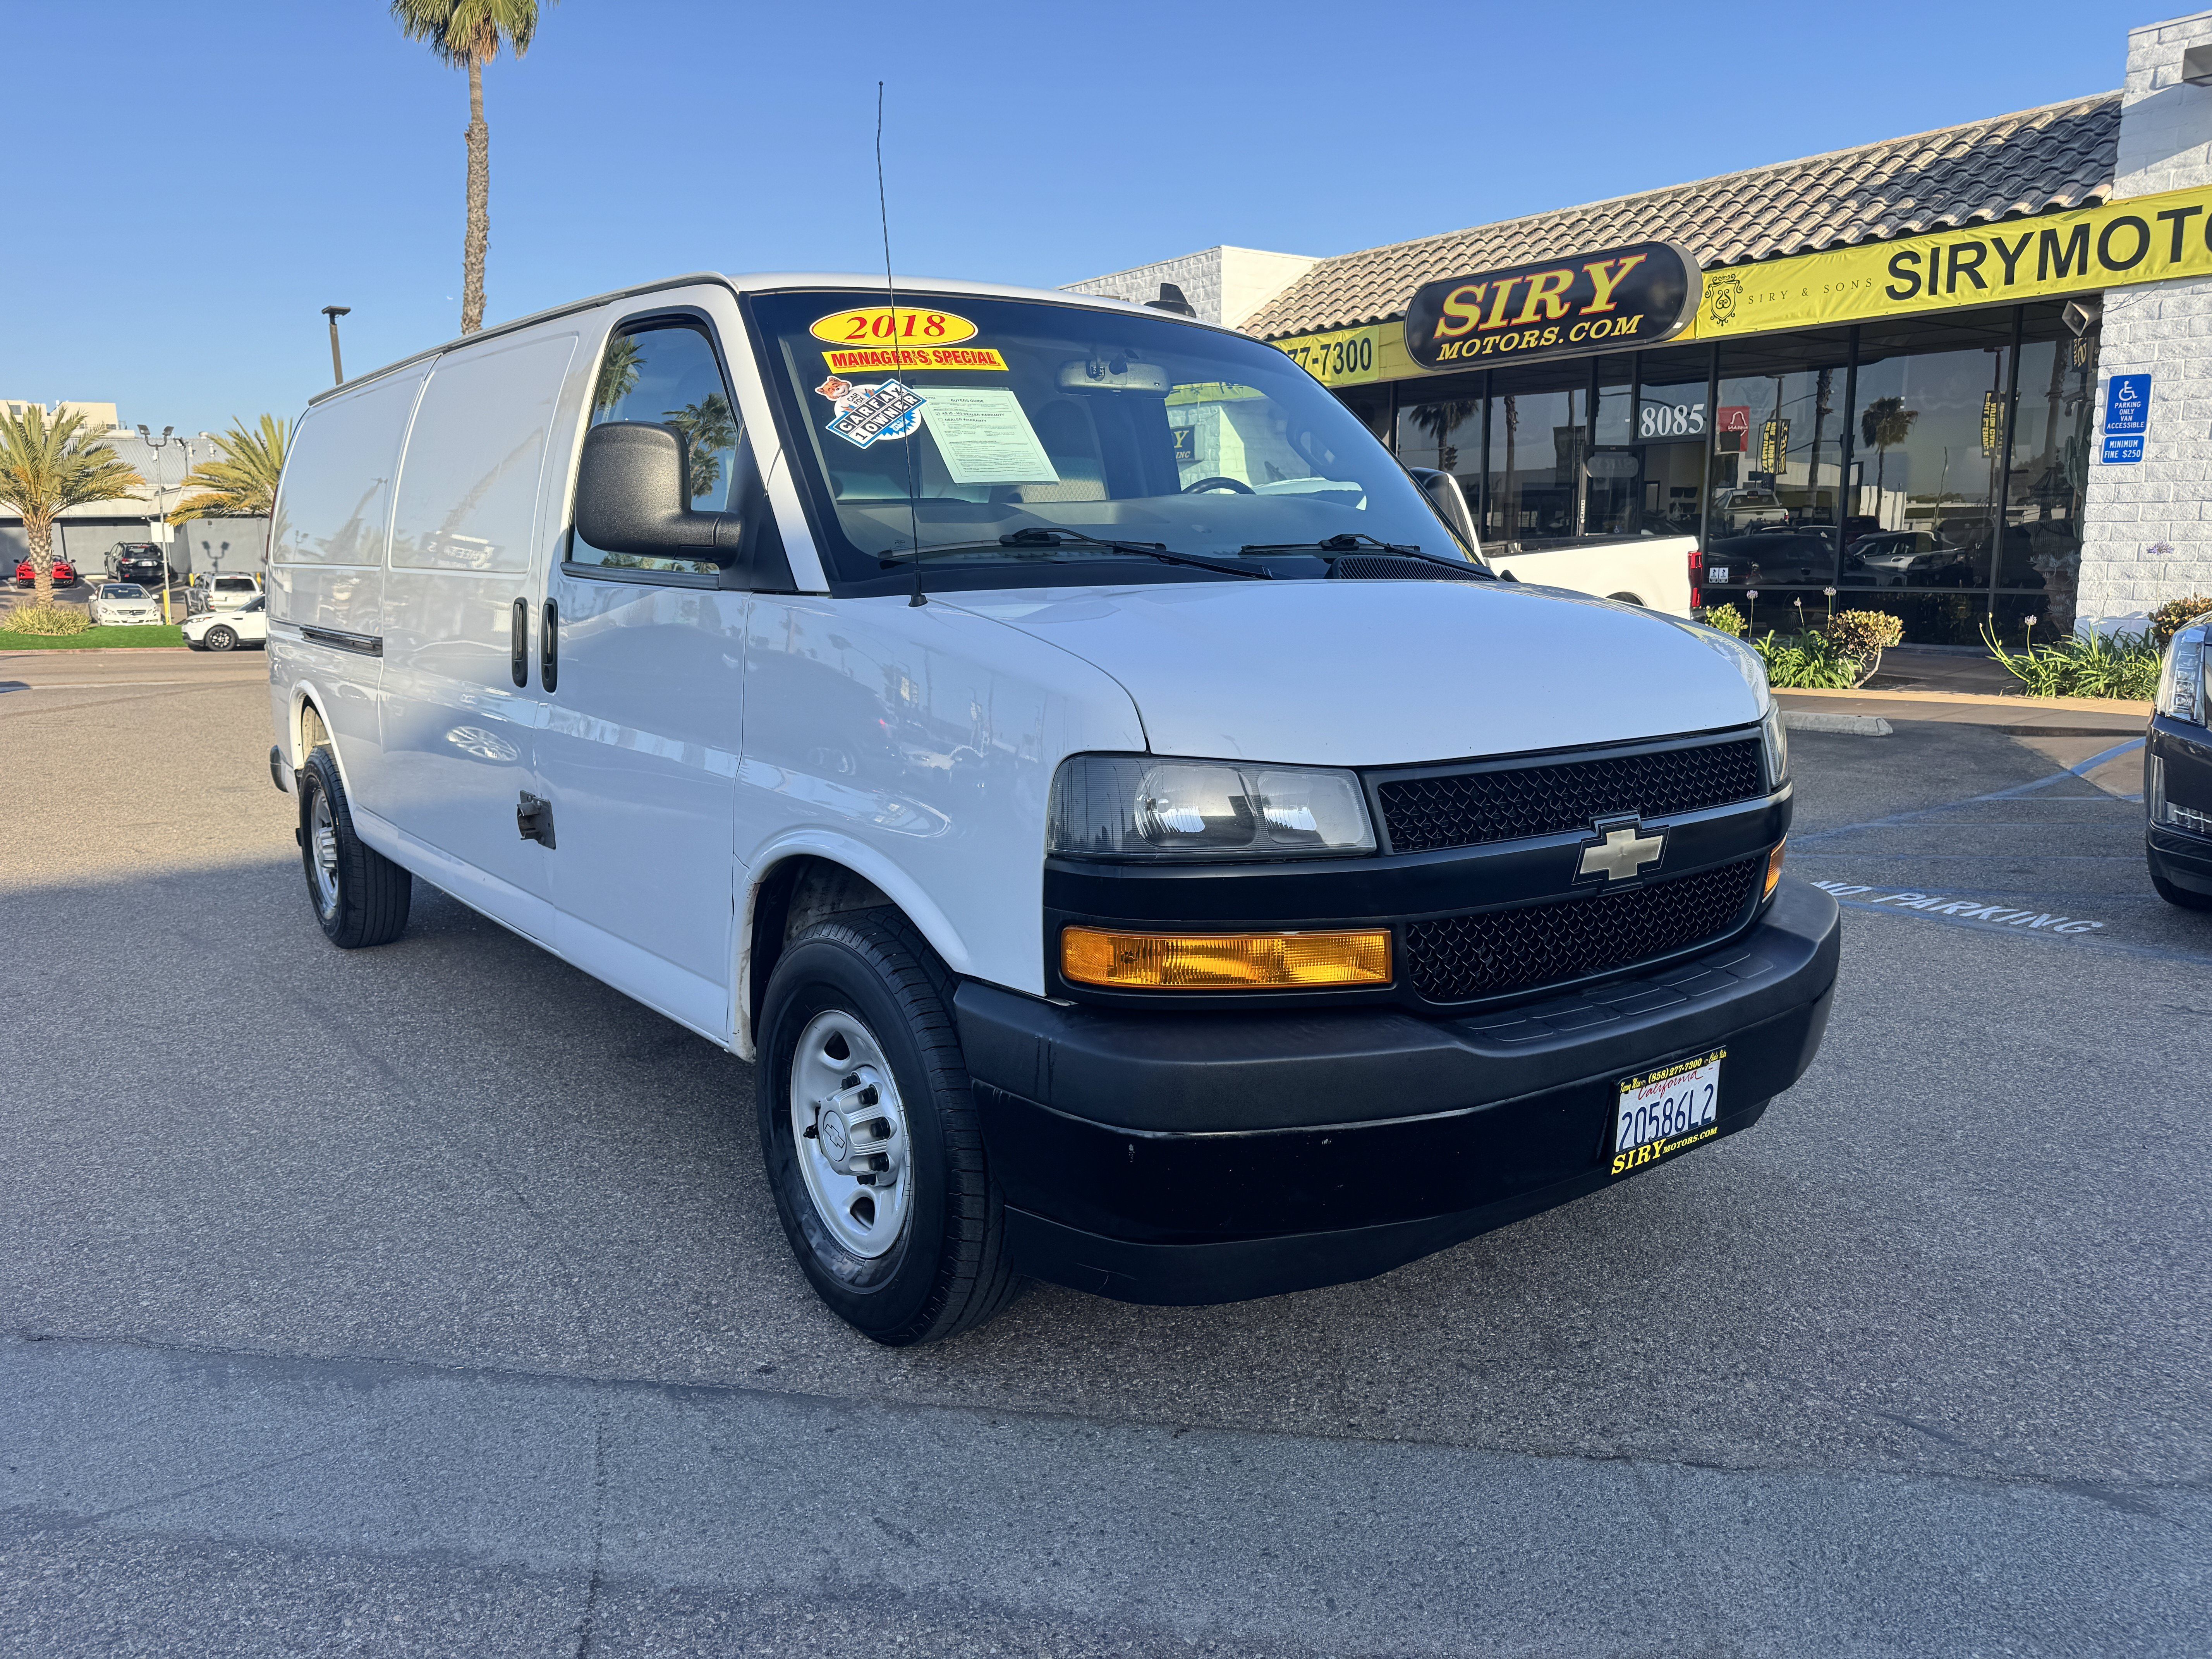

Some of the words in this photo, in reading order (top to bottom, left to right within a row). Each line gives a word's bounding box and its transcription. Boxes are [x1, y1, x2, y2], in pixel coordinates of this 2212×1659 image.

[1885, 205, 2212, 301] SIRYMOT
[1433, 253, 1647, 338] SIRY
[1748, 290, 1788, 304] SIRY
[1802, 287, 1809, 297] &
[1824, 278, 1872, 294] SONS
[844, 314, 945, 340] 2018
[1436, 314, 1644, 361] MOTORS.COM
[831, 350, 931, 367] MANAGER'S
[933, 350, 999, 366] SPECIAL
[839, 387, 905, 431] CARFAX
[847, 393, 860, 402] CAR
[853, 397, 866, 405] FOX
[866, 393, 918, 432] OWNER
[1641, 404, 1704, 437] 8085
[2107, 421, 2145, 429] ACCESSIBLE
[2104, 450, 2119, 459] FINE
[2122, 449, 2141, 459] $250
[2109, 440, 2138, 449] MINIMUM
[1871, 892, 2103, 933] PARKING
[1638, 1070, 1704, 1100] California
[1619, 1083, 1714, 1151] 20586L2
[1611, 1139, 1666, 1175] SIRY
[1662, 1127, 1718, 1154] MOTORS.COM
